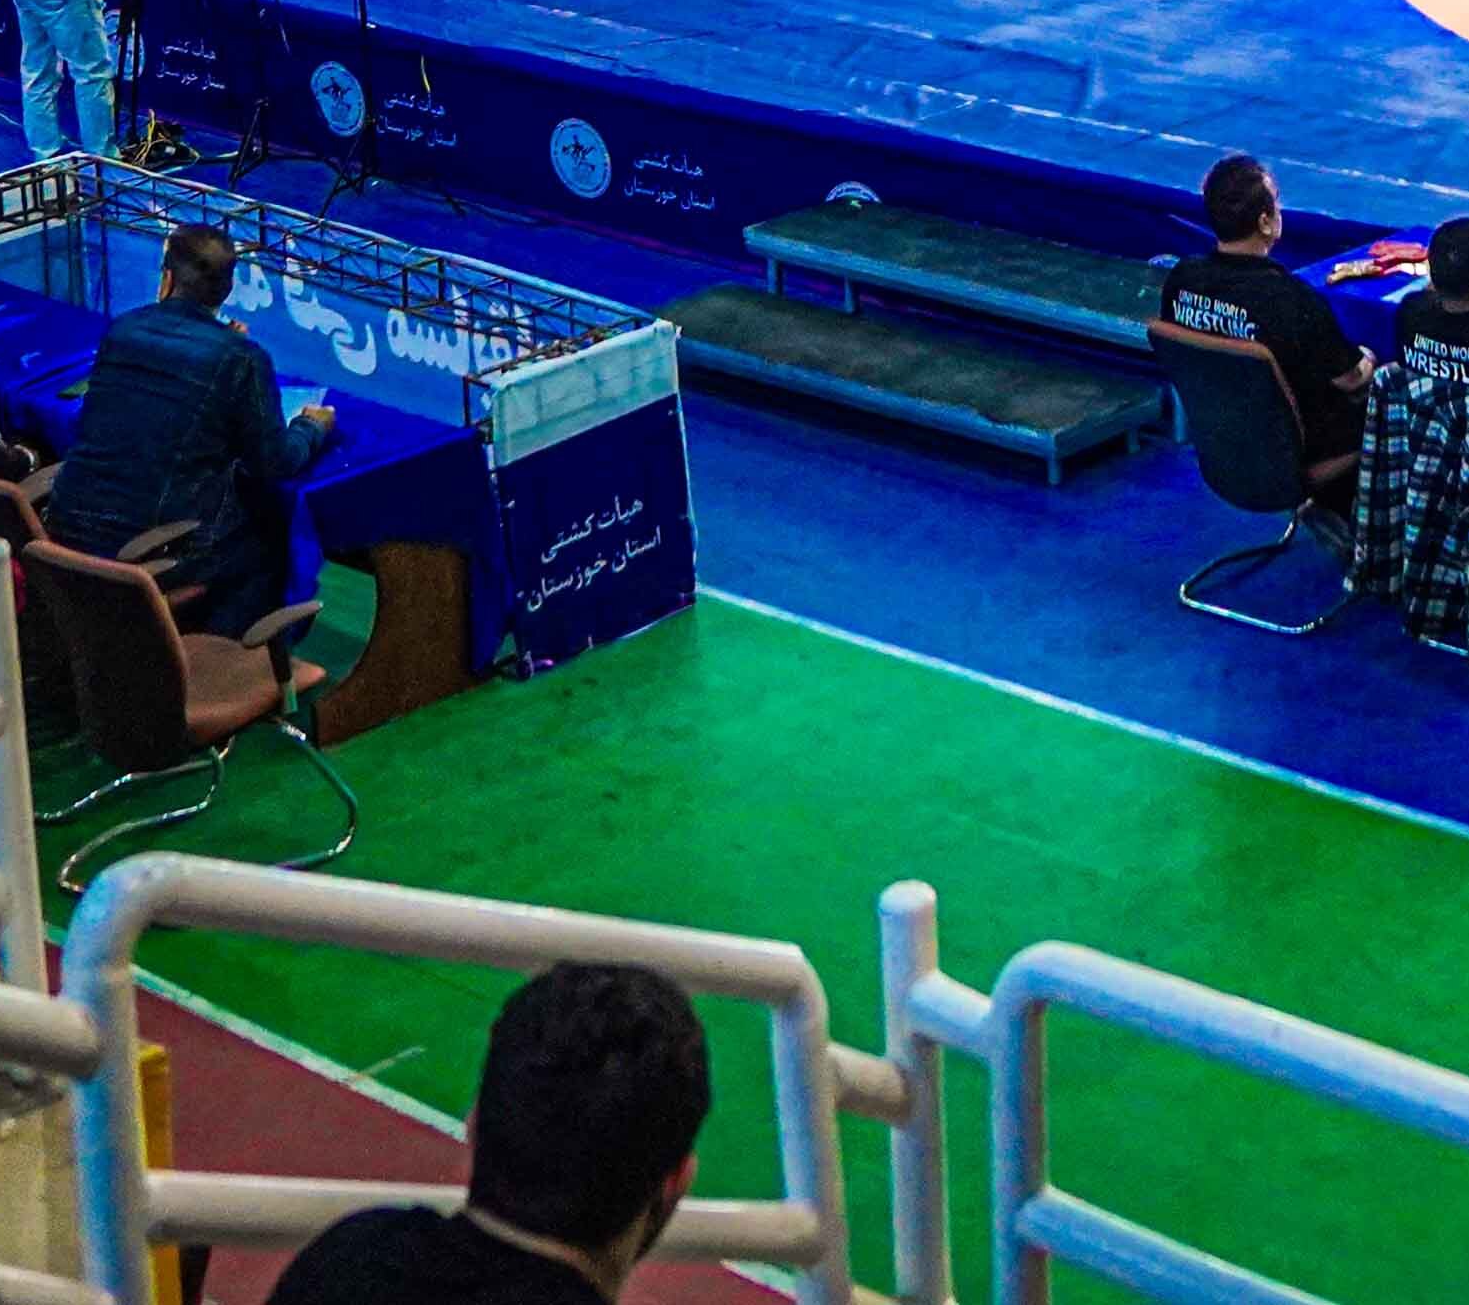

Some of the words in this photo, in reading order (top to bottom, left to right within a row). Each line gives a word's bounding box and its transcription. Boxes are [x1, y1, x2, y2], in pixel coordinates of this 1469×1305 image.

[1172, 299, 1257, 341] WRESTLING
[1179, 289, 1212, 310] UNITED
[1213, 298, 1247, 322] WORLD
[1414, 332, 1448, 358] UNITED
[540, 513, 595, 564] کشتی
[611, 525, 661, 573] استان
[527, 552, 607, 612] خوزستان
